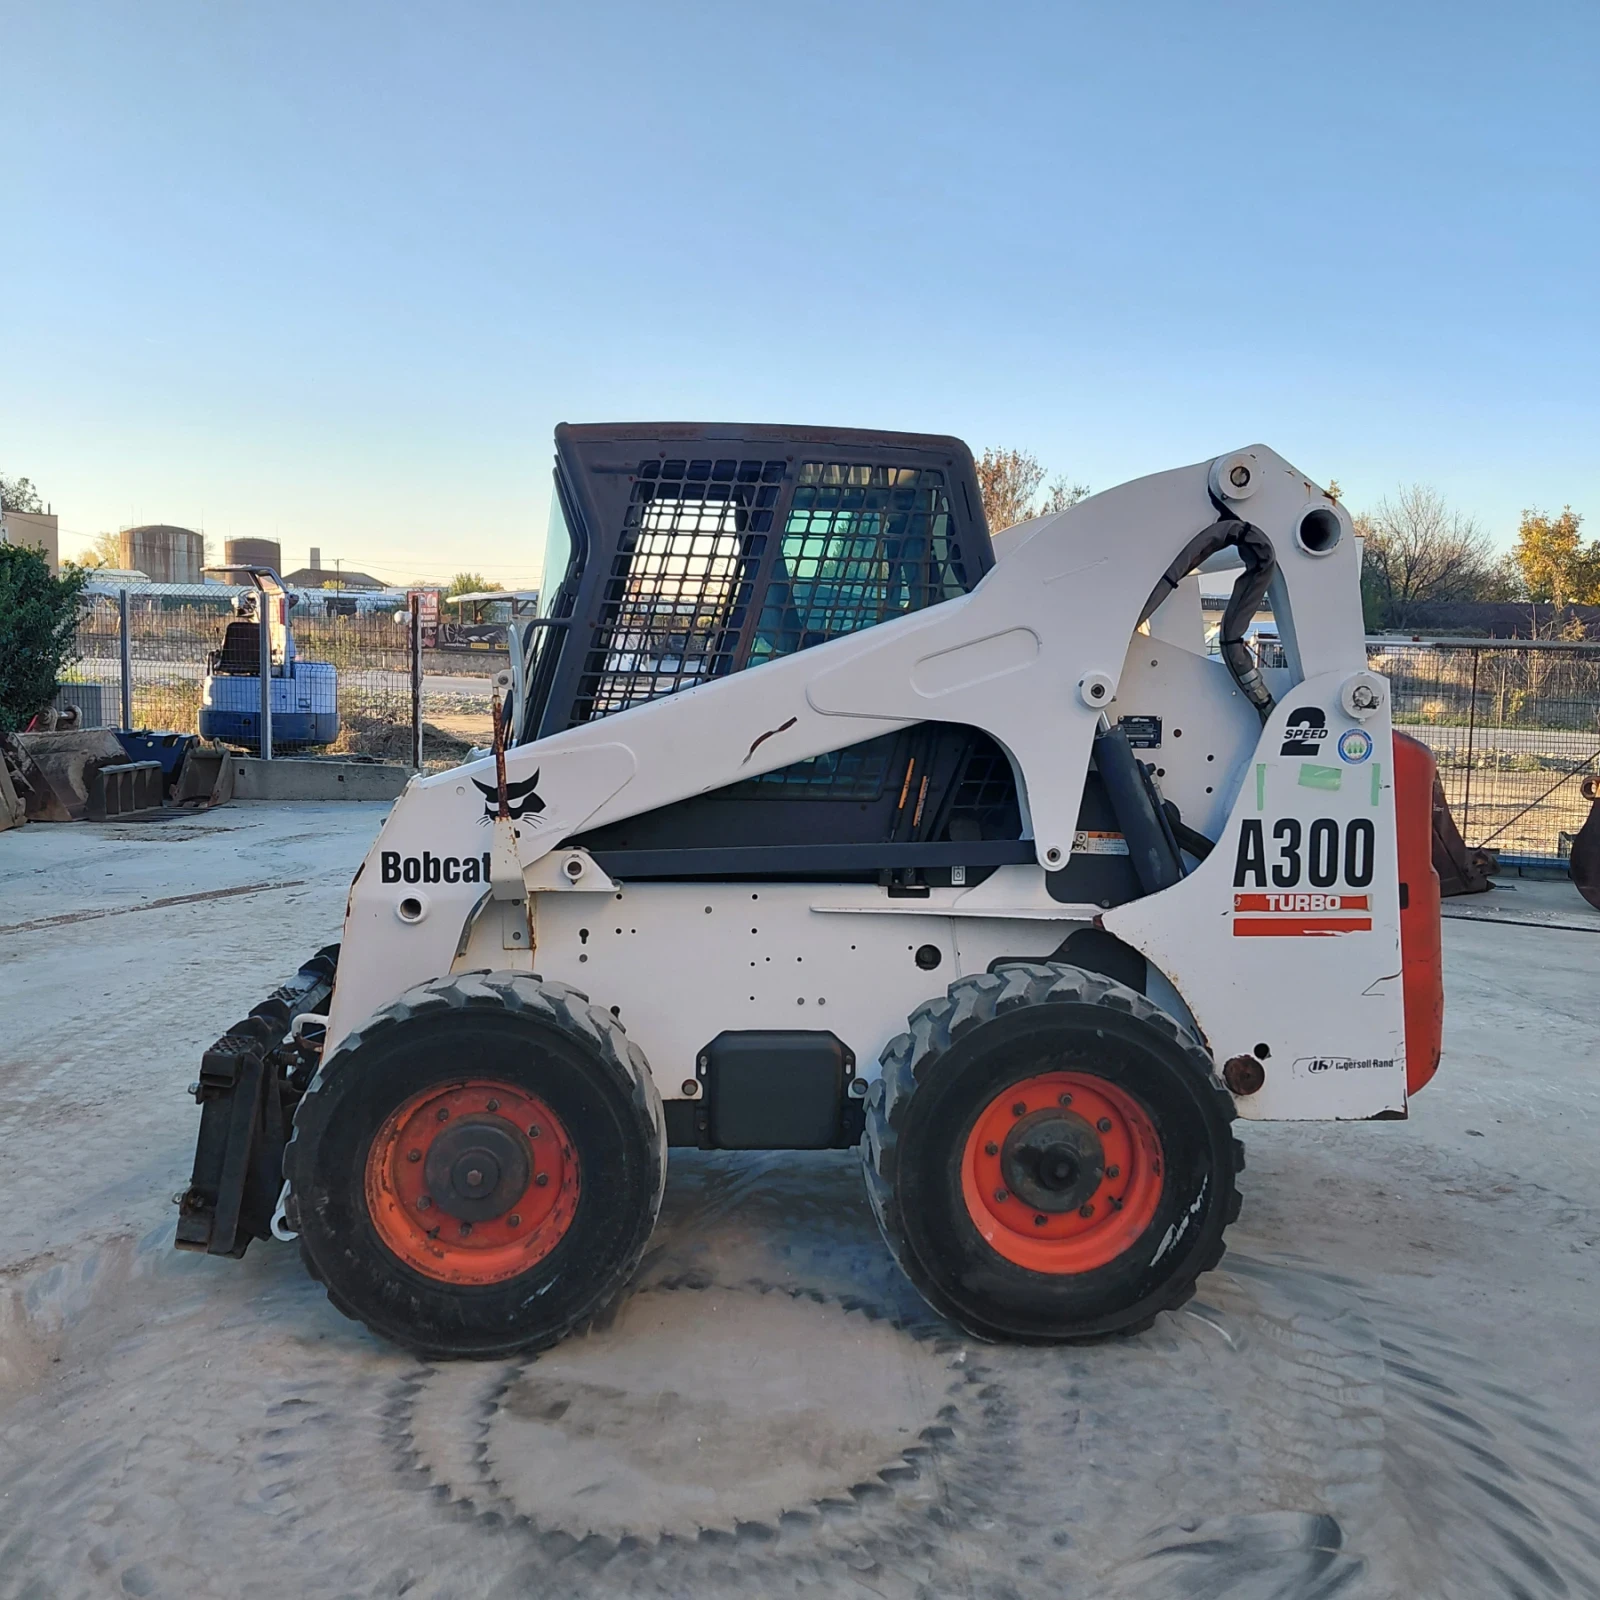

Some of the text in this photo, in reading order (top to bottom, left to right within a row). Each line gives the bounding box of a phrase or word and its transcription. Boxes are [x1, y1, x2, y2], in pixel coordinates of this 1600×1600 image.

[1280, 706, 1326, 756] 2
[1284, 729, 1328, 739] SPEED
[381, 851, 491, 884] Bobcat
[1233, 818, 1375, 888] A300
[1266, 894, 1341, 911] TURBO
